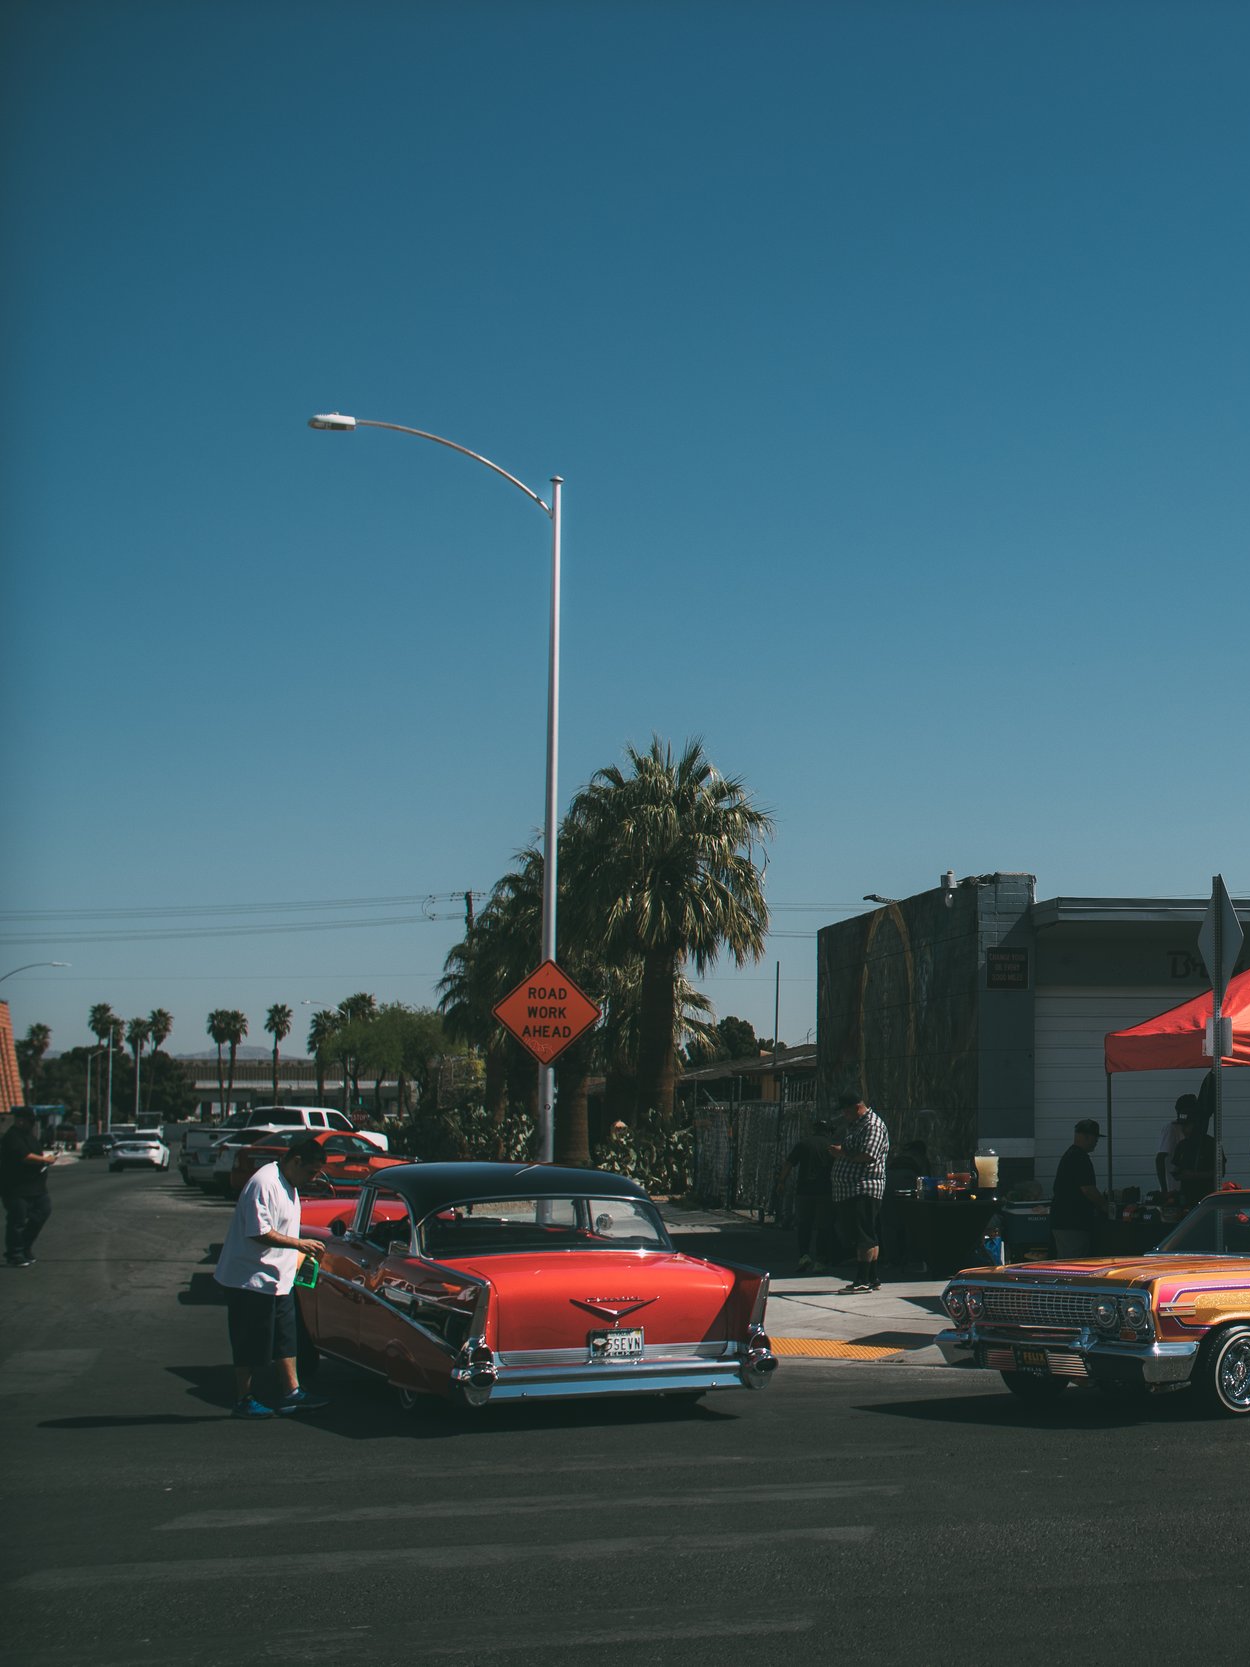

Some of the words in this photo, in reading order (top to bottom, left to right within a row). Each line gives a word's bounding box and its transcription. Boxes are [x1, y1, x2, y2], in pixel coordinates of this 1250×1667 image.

[528, 987, 567, 1000] ROAD
[527, 1006, 567, 1019] WORK
[521, 1025, 572, 1038] AHEAD
